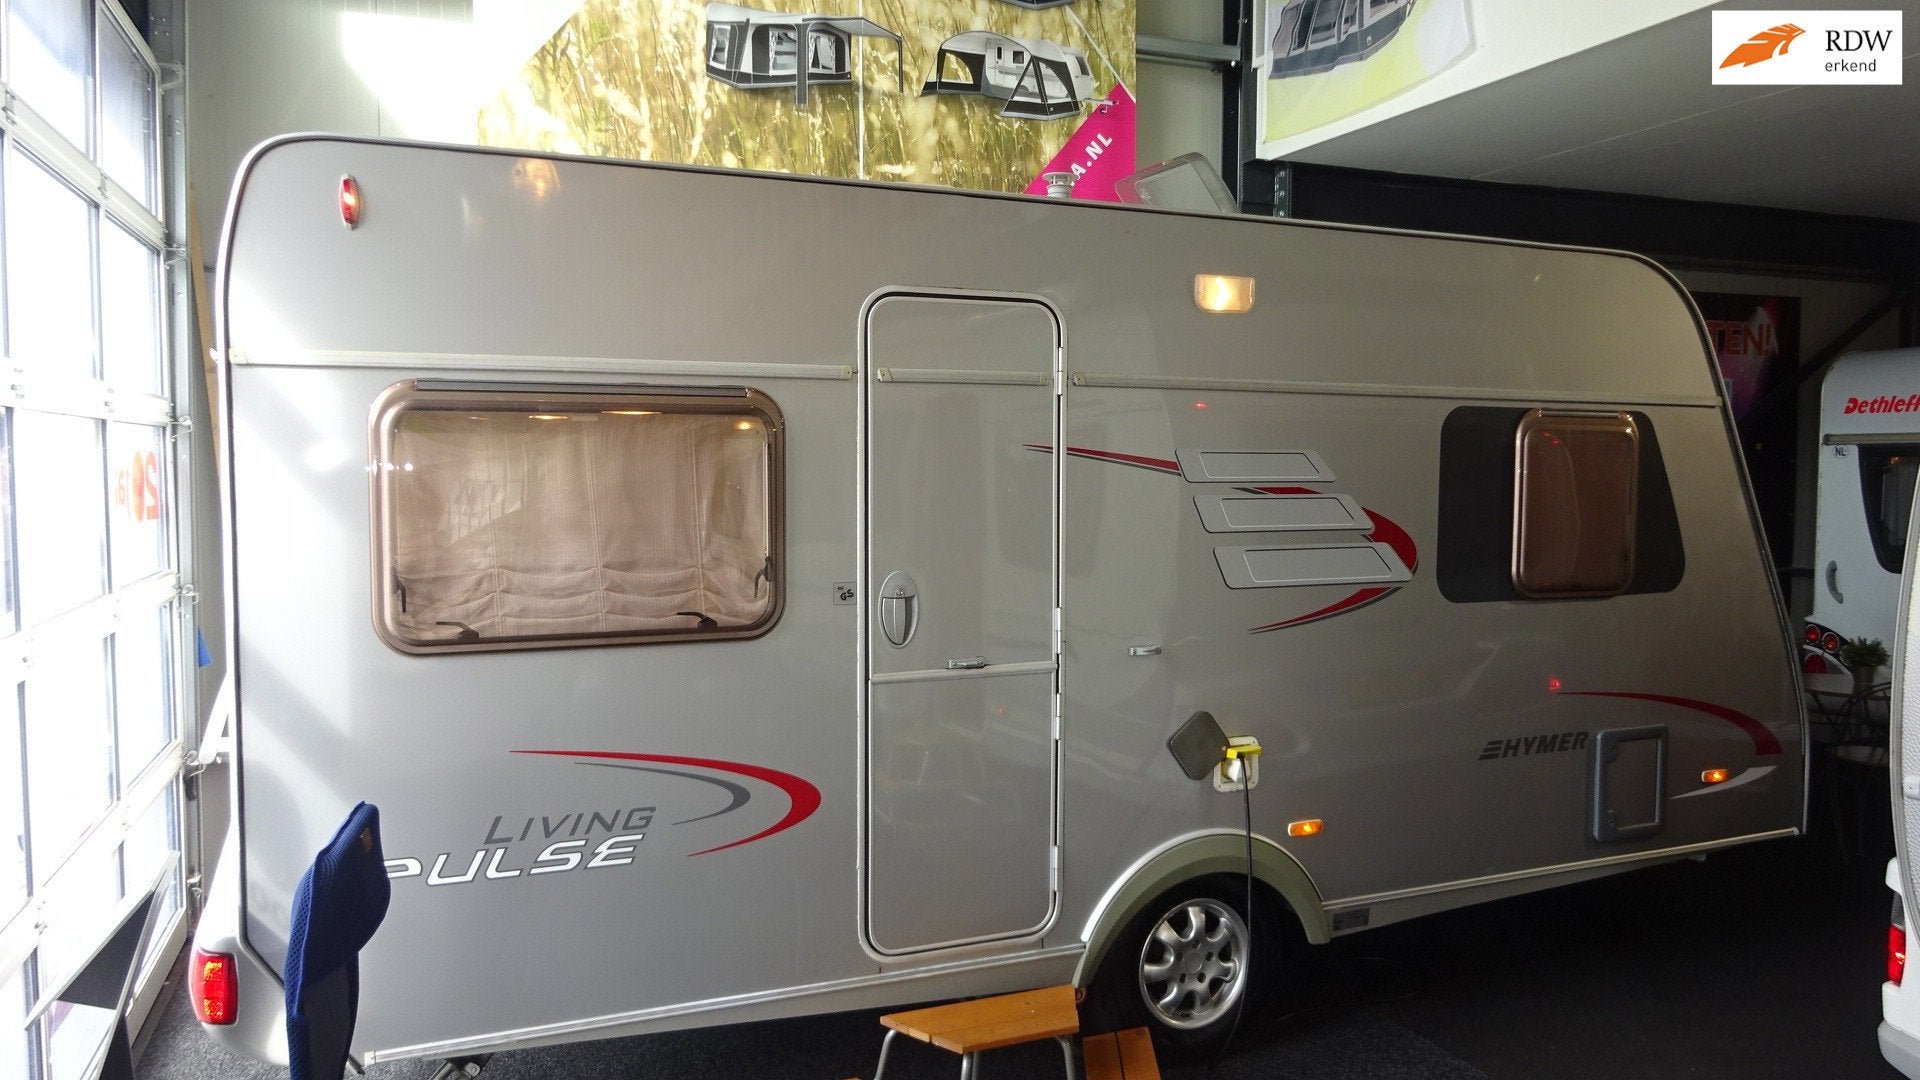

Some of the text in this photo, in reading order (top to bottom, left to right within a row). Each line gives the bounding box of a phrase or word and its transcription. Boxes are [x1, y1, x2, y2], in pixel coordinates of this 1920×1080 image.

[1070, 133, 1113, 187] A.NL
[1834, 446, 1847, 457] NL
[1500, 731, 1590, 759] HYMER
[484, 806, 656, 845] LIVING
